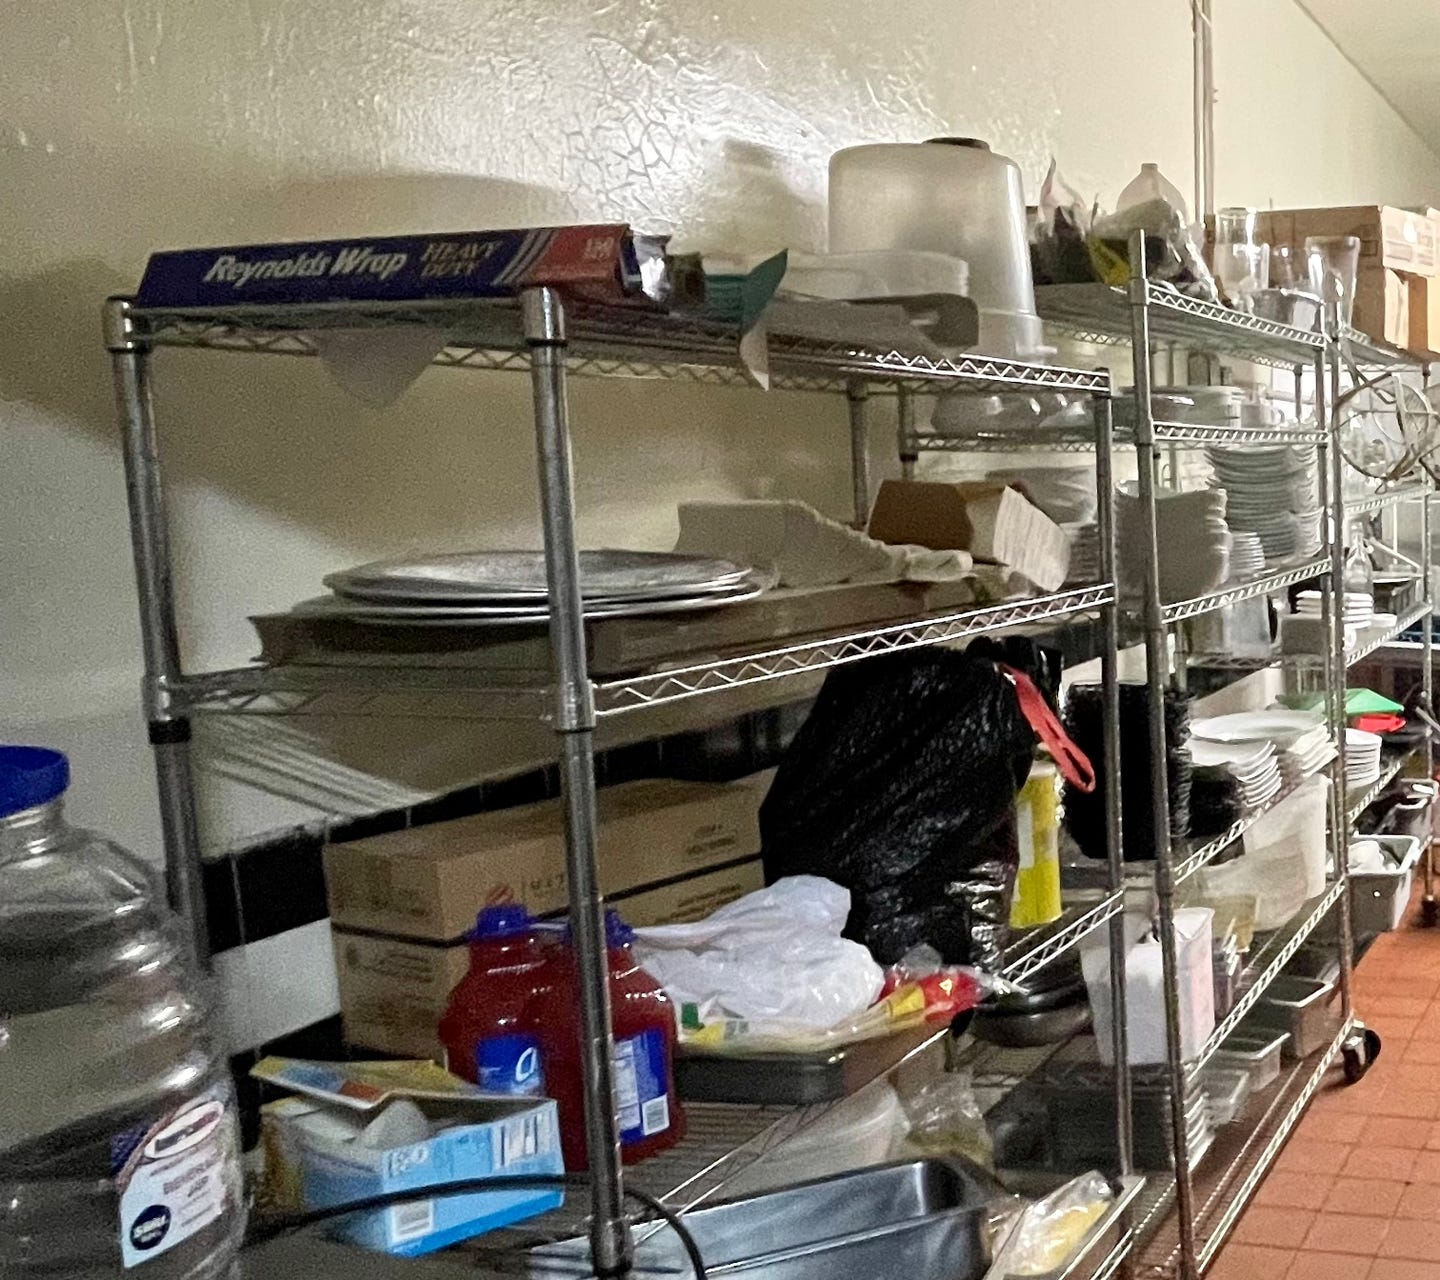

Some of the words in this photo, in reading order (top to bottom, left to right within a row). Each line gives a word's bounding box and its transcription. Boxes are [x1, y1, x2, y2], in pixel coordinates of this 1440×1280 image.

[421, 241, 501, 261] HEAVY
[203, 252, 332, 289] Reynolds
[329, 247, 408, 281] Wrap
